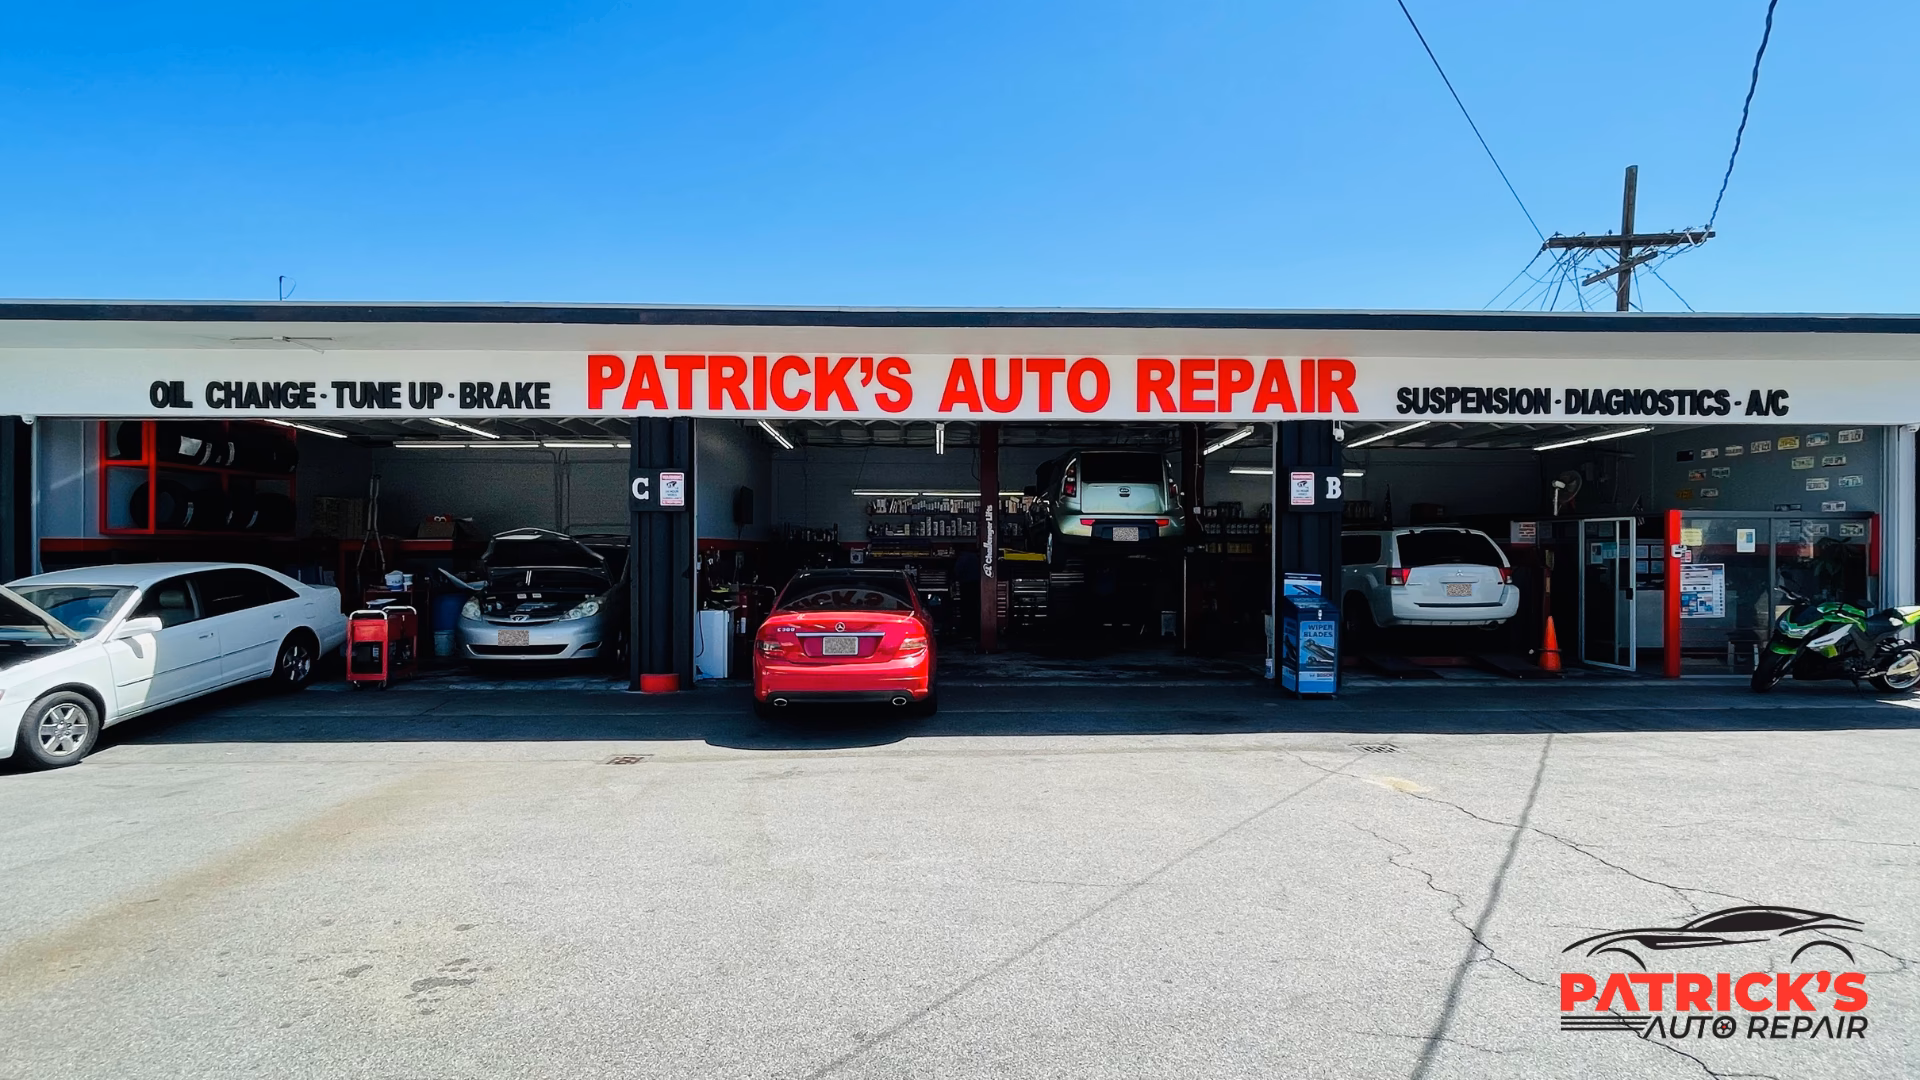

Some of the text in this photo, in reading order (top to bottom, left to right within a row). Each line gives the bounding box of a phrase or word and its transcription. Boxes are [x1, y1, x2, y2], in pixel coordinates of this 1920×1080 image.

[150, 381, 550, 409] OIL CHANGE TUNE UP BRAKE
[588, 355, 1358, 413] PATRICK'S AUTO REPAIR
[1397, 387, 1789, 416] SUSPENSION DIAGNOSTICS A/C
[632, 477, 649, 501] C
[1326, 476, 1342, 499] B
[983, 522, 994, 564] Challenger
